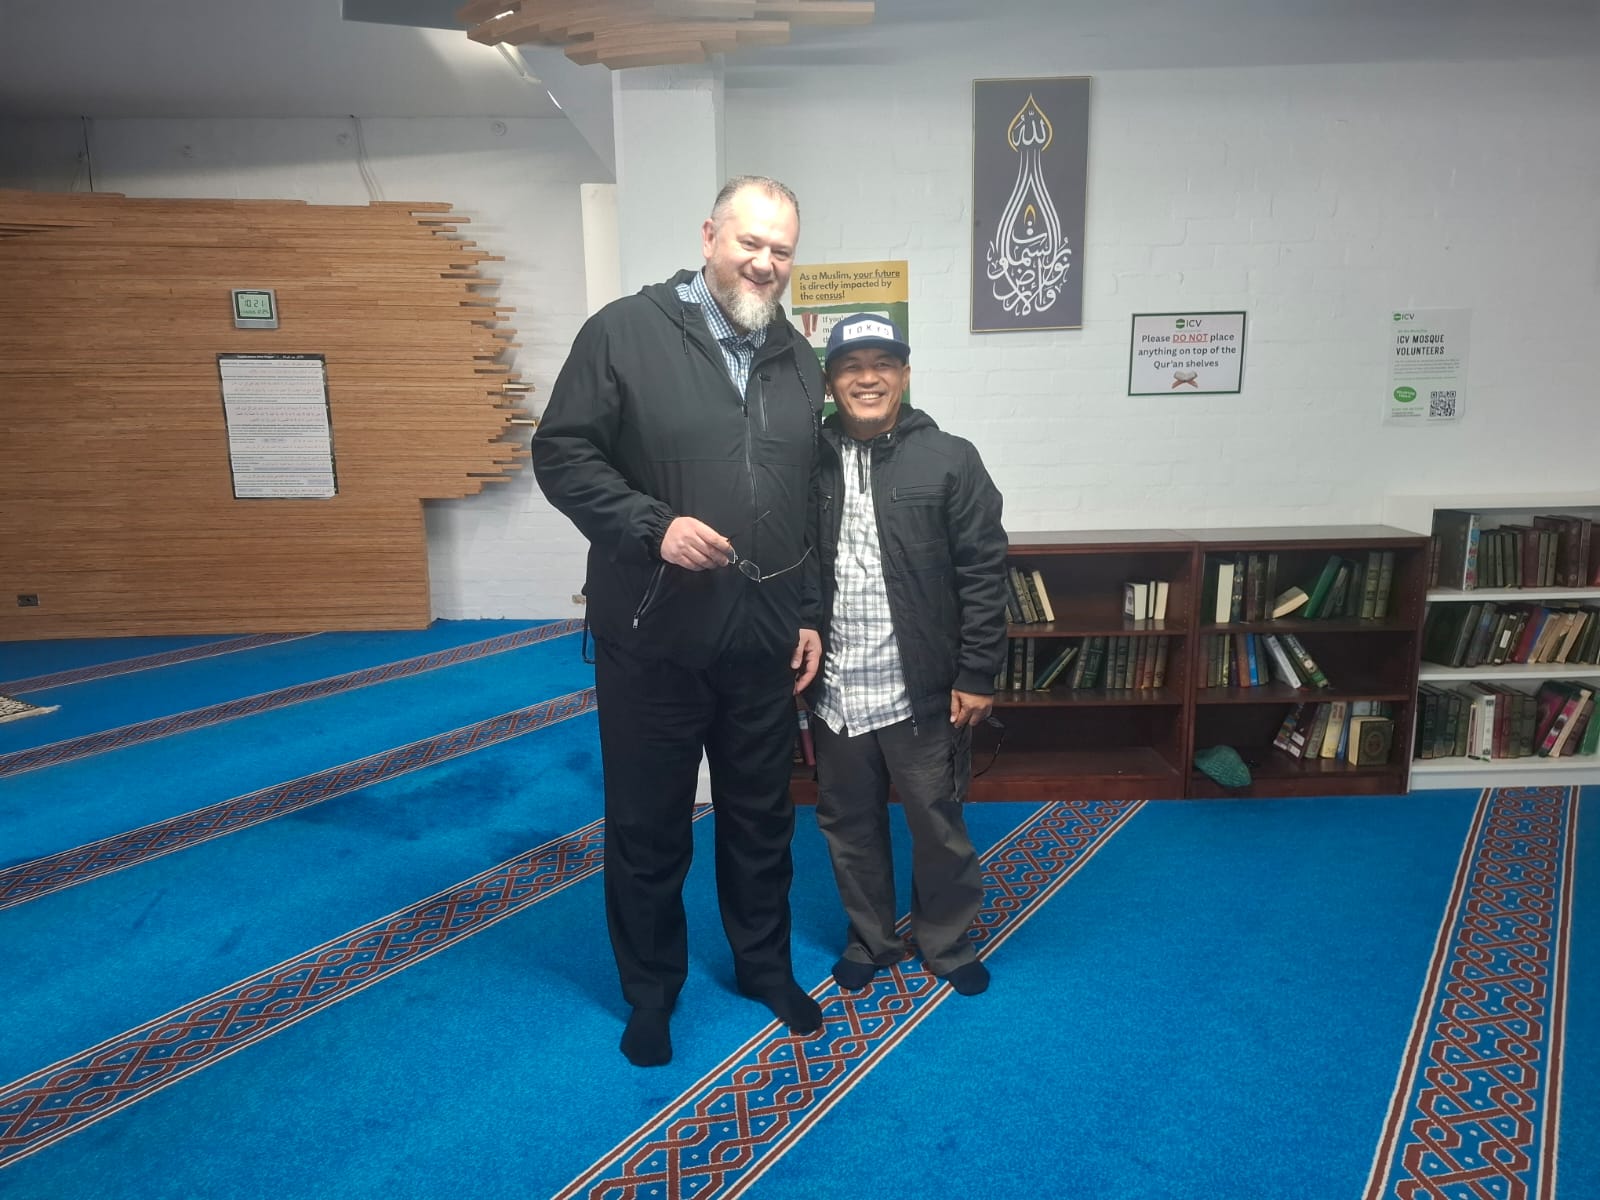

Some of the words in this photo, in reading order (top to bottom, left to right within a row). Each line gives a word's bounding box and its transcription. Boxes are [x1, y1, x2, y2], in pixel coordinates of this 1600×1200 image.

[800, 272, 810, 281] As
[819, 271, 851, 280] Muslim,
[853, 272, 873, 280] your
[875, 269, 901, 278] future
[800, 282, 806, 291] is
[808, 281, 839, 291] directly
[841, 279, 879, 291] impacted
[881, 278, 892, 288] by
[800, 291, 814, 300] the
[815, 290, 845, 301] census!
[1186, 319, 1202, 328] ICV
[1141, 334, 1171, 343] Please
[1173, 334, 1187, 342] DO
[1188, 333, 1208, 342] NOT
[1210, 333, 1235, 343] place
[1396, 335, 1410, 344] ICV
[1412, 334, 1445, 344] MOSQUE
[1138, 347, 1177, 358] anything
[1193, 347, 1208, 356] top
[1210, 346, 1220, 354] of
[1221, 346, 1236, 354] the
[1396, 346, 1445, 356] VOLUNTEERS
[1153, 360, 1184, 370] Qur'an
[1185, 359, 1219, 368] shelves
